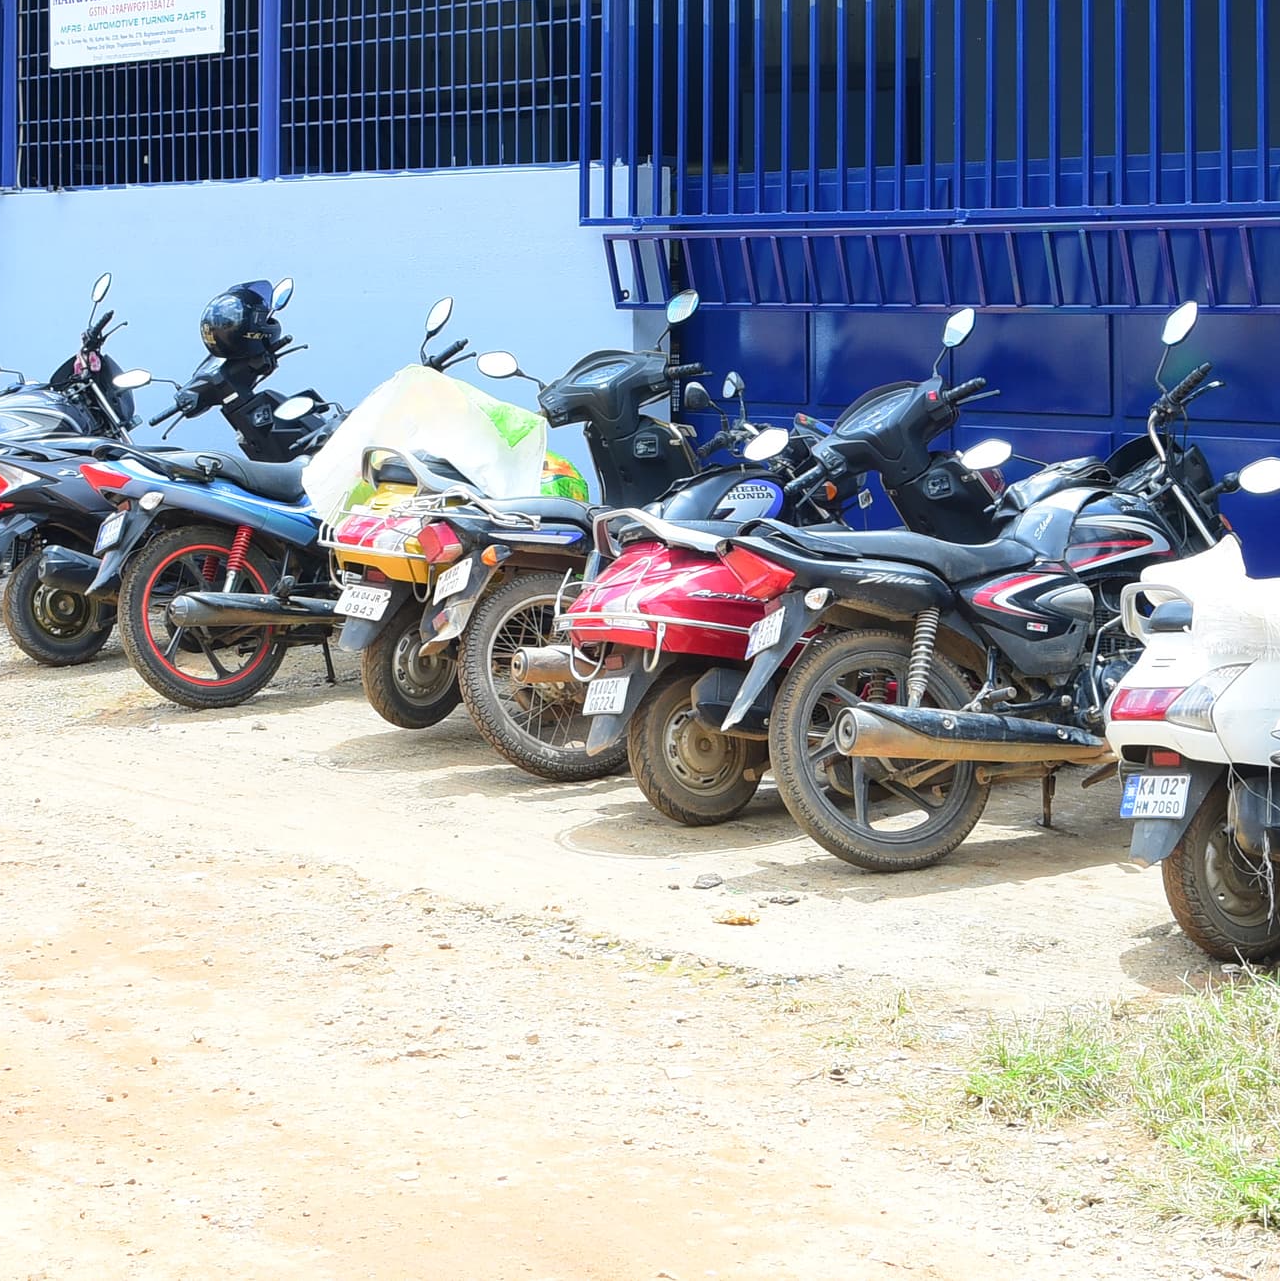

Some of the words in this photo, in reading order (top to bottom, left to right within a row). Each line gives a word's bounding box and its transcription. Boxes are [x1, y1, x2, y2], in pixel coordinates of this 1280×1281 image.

[89, 4, 108, 17] GSTIN
[87, 18, 139, 32] AUTOMOTIVE
[141, 14, 175, 26] TURNING
[177, 10, 207, 22] PARTS
[733, 484, 769, 493] HERO
[727, 492, 774, 501] HONDA
[857, 571, 932, 586] Shine
[344, 604, 375, 617] 0943
[1138, 778, 1156, 796] KA
[1160, 777, 1180, 796] 02
[1134, 800, 1150, 815] HM
[1151, 800, 1181, 815] 7060
